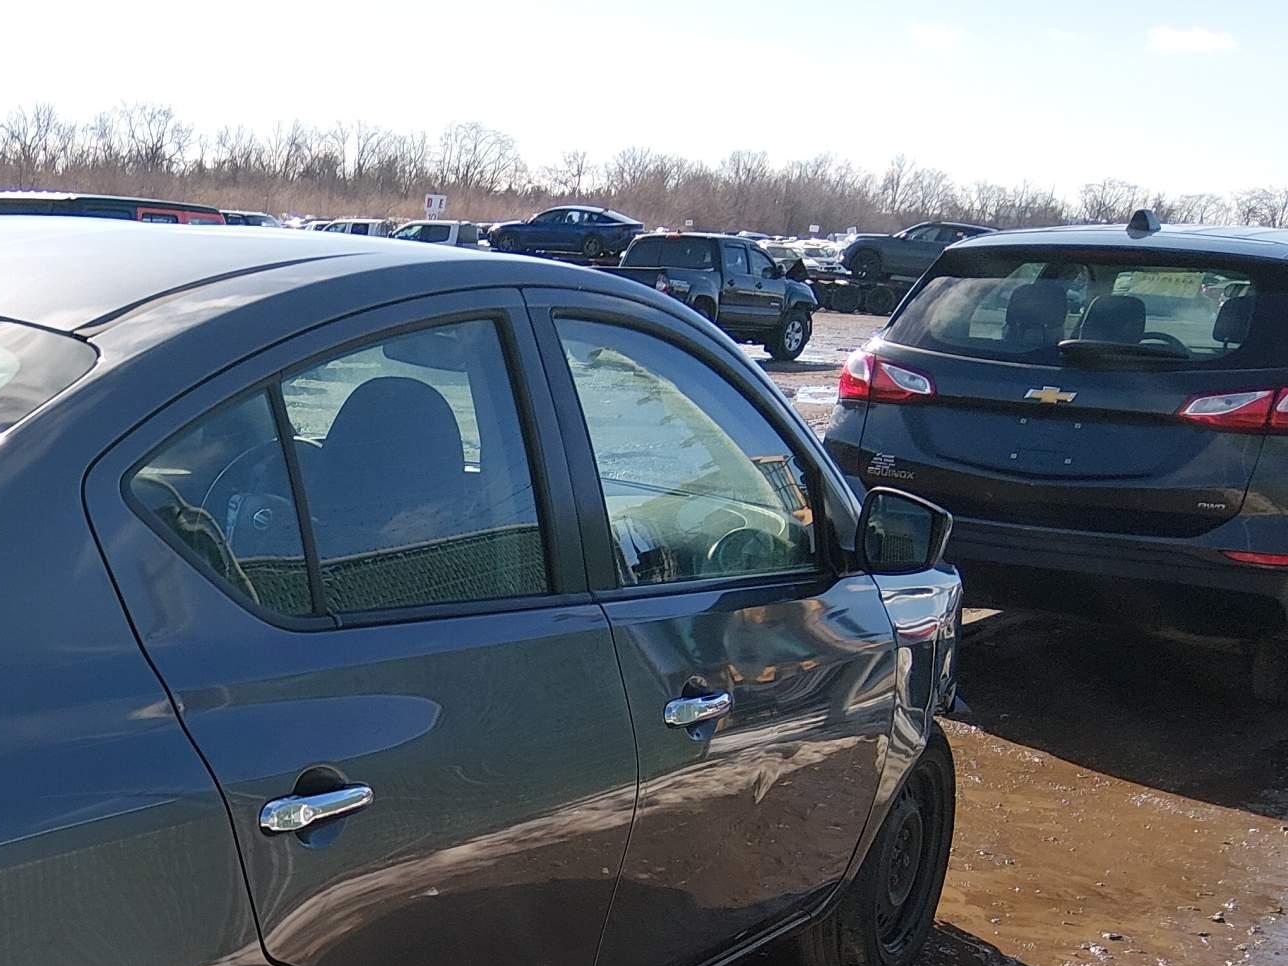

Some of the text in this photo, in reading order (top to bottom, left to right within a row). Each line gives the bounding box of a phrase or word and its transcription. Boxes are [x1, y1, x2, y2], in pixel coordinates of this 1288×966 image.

[426, 198, 444, 208] D E
[867, 468, 915, 480] EQUINOX
